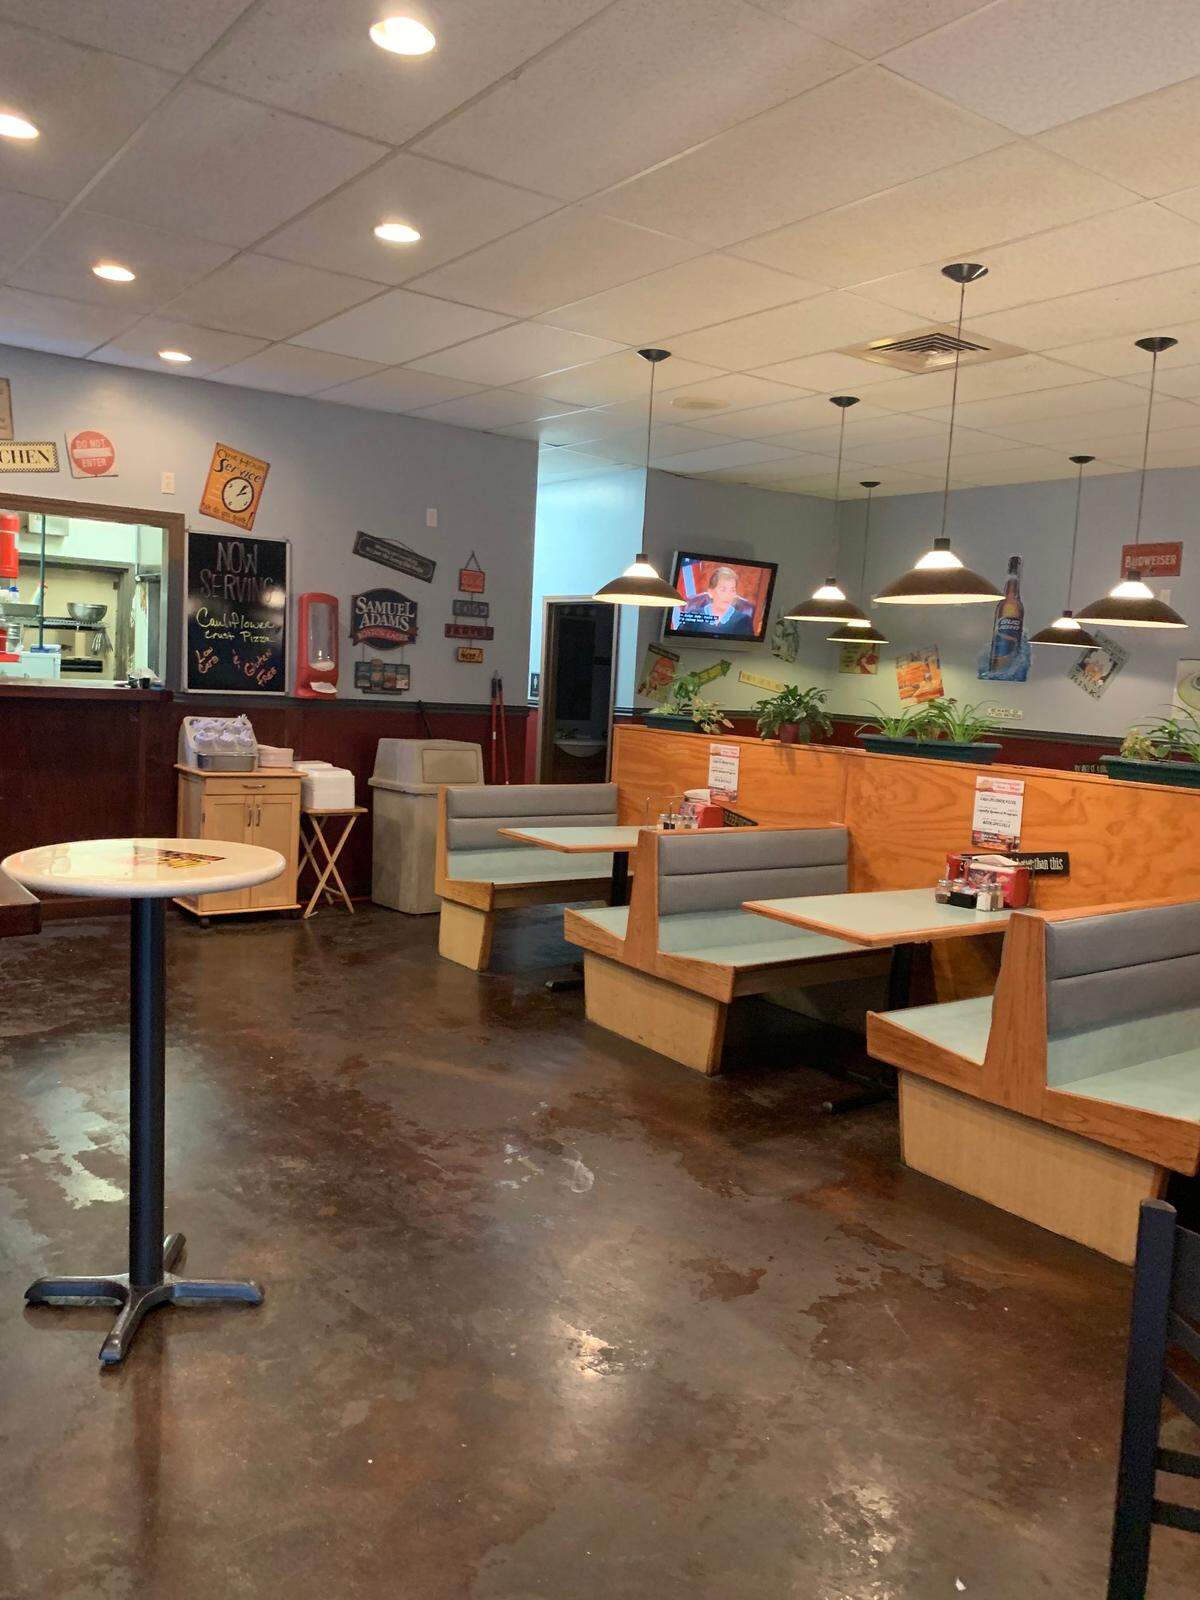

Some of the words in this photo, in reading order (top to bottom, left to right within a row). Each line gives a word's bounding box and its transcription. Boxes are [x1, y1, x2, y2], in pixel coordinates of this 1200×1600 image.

[75, 440, 88, 449] DO
[89, 438, 106, 448] NOT
[81, 457, 108, 468] ENTER
[216, 541, 258, 575] NOW
[200, 568, 274, 603] SERVING
[355, 596, 415, 618] SAMUEL
[360, 613, 410, 632] ADAMS
[1050, 857, 1064, 870] this
